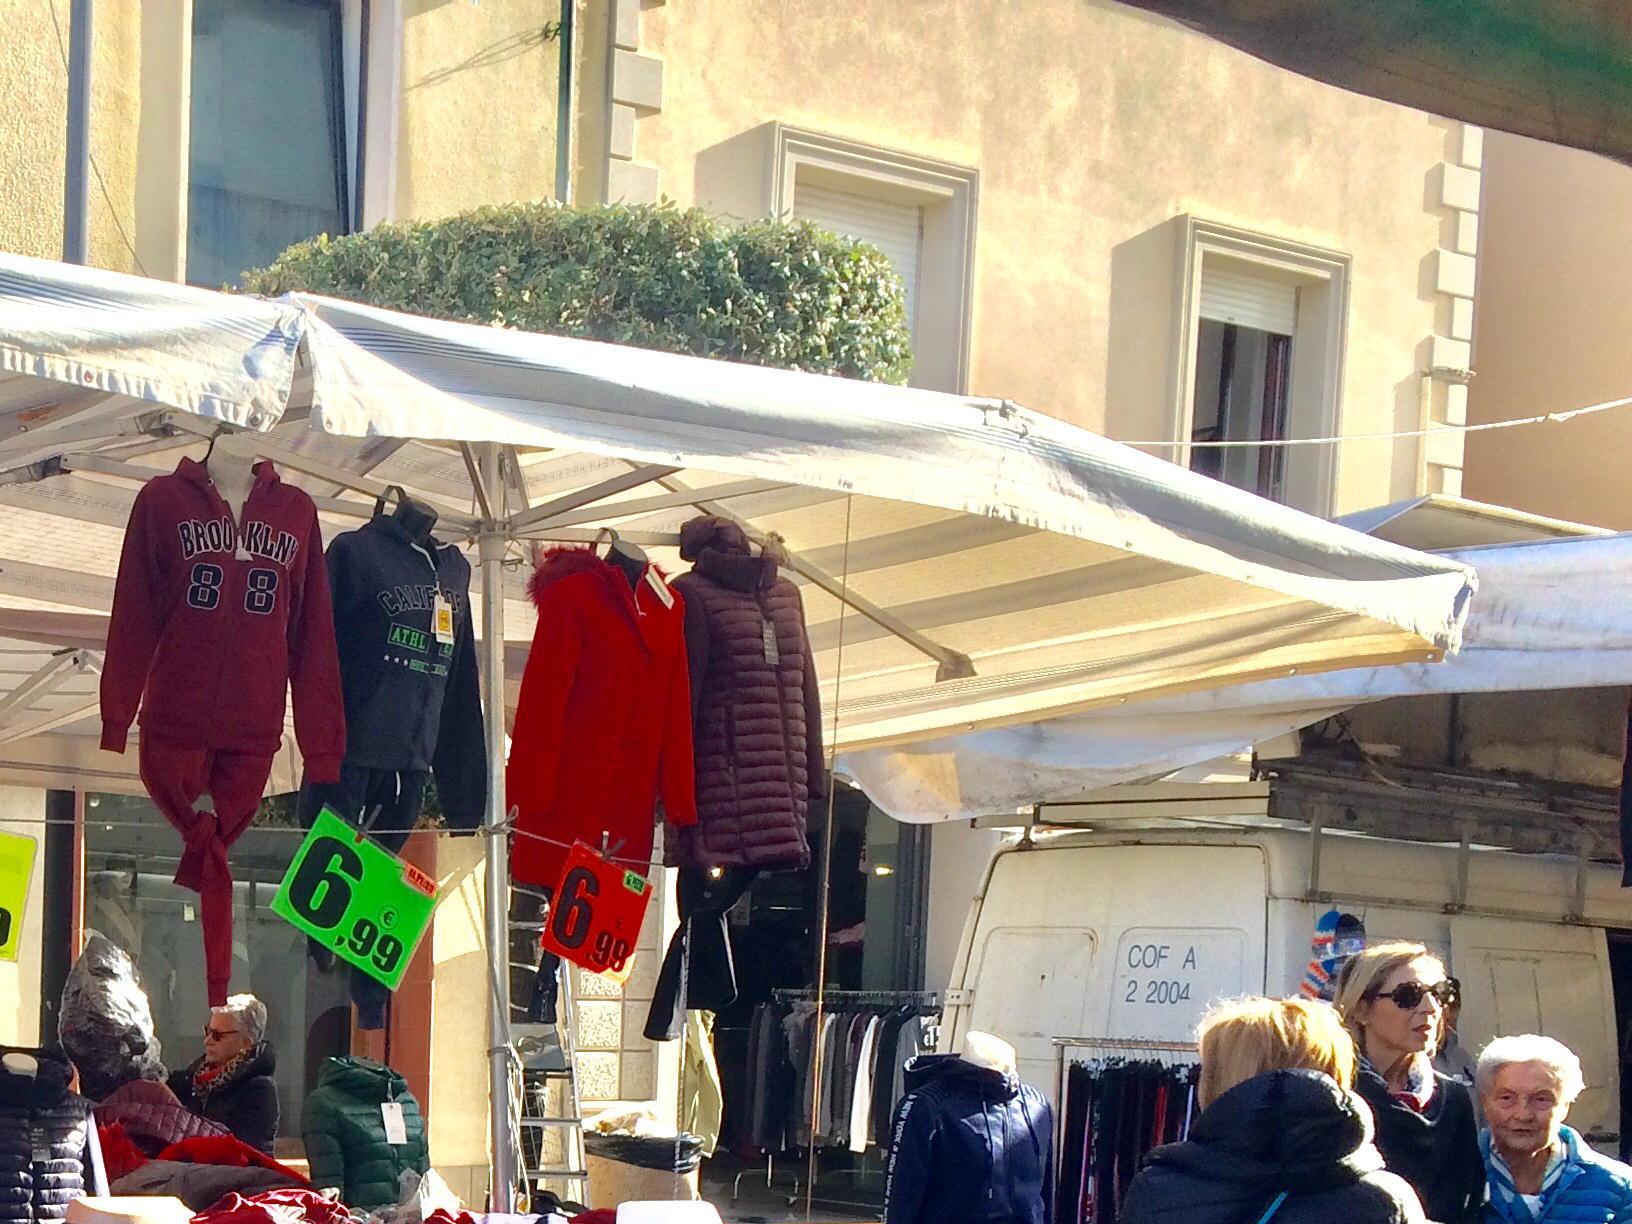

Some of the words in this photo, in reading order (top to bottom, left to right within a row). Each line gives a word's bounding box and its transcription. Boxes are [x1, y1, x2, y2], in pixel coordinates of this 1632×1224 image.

[288, 836, 404, 973] 6,99
[1128, 944, 1170, 968] COF
[1182, 946, 1196, 970] A
[1125, 980, 1138, 1003] 2
[1145, 980, 1191, 1004] 2004
